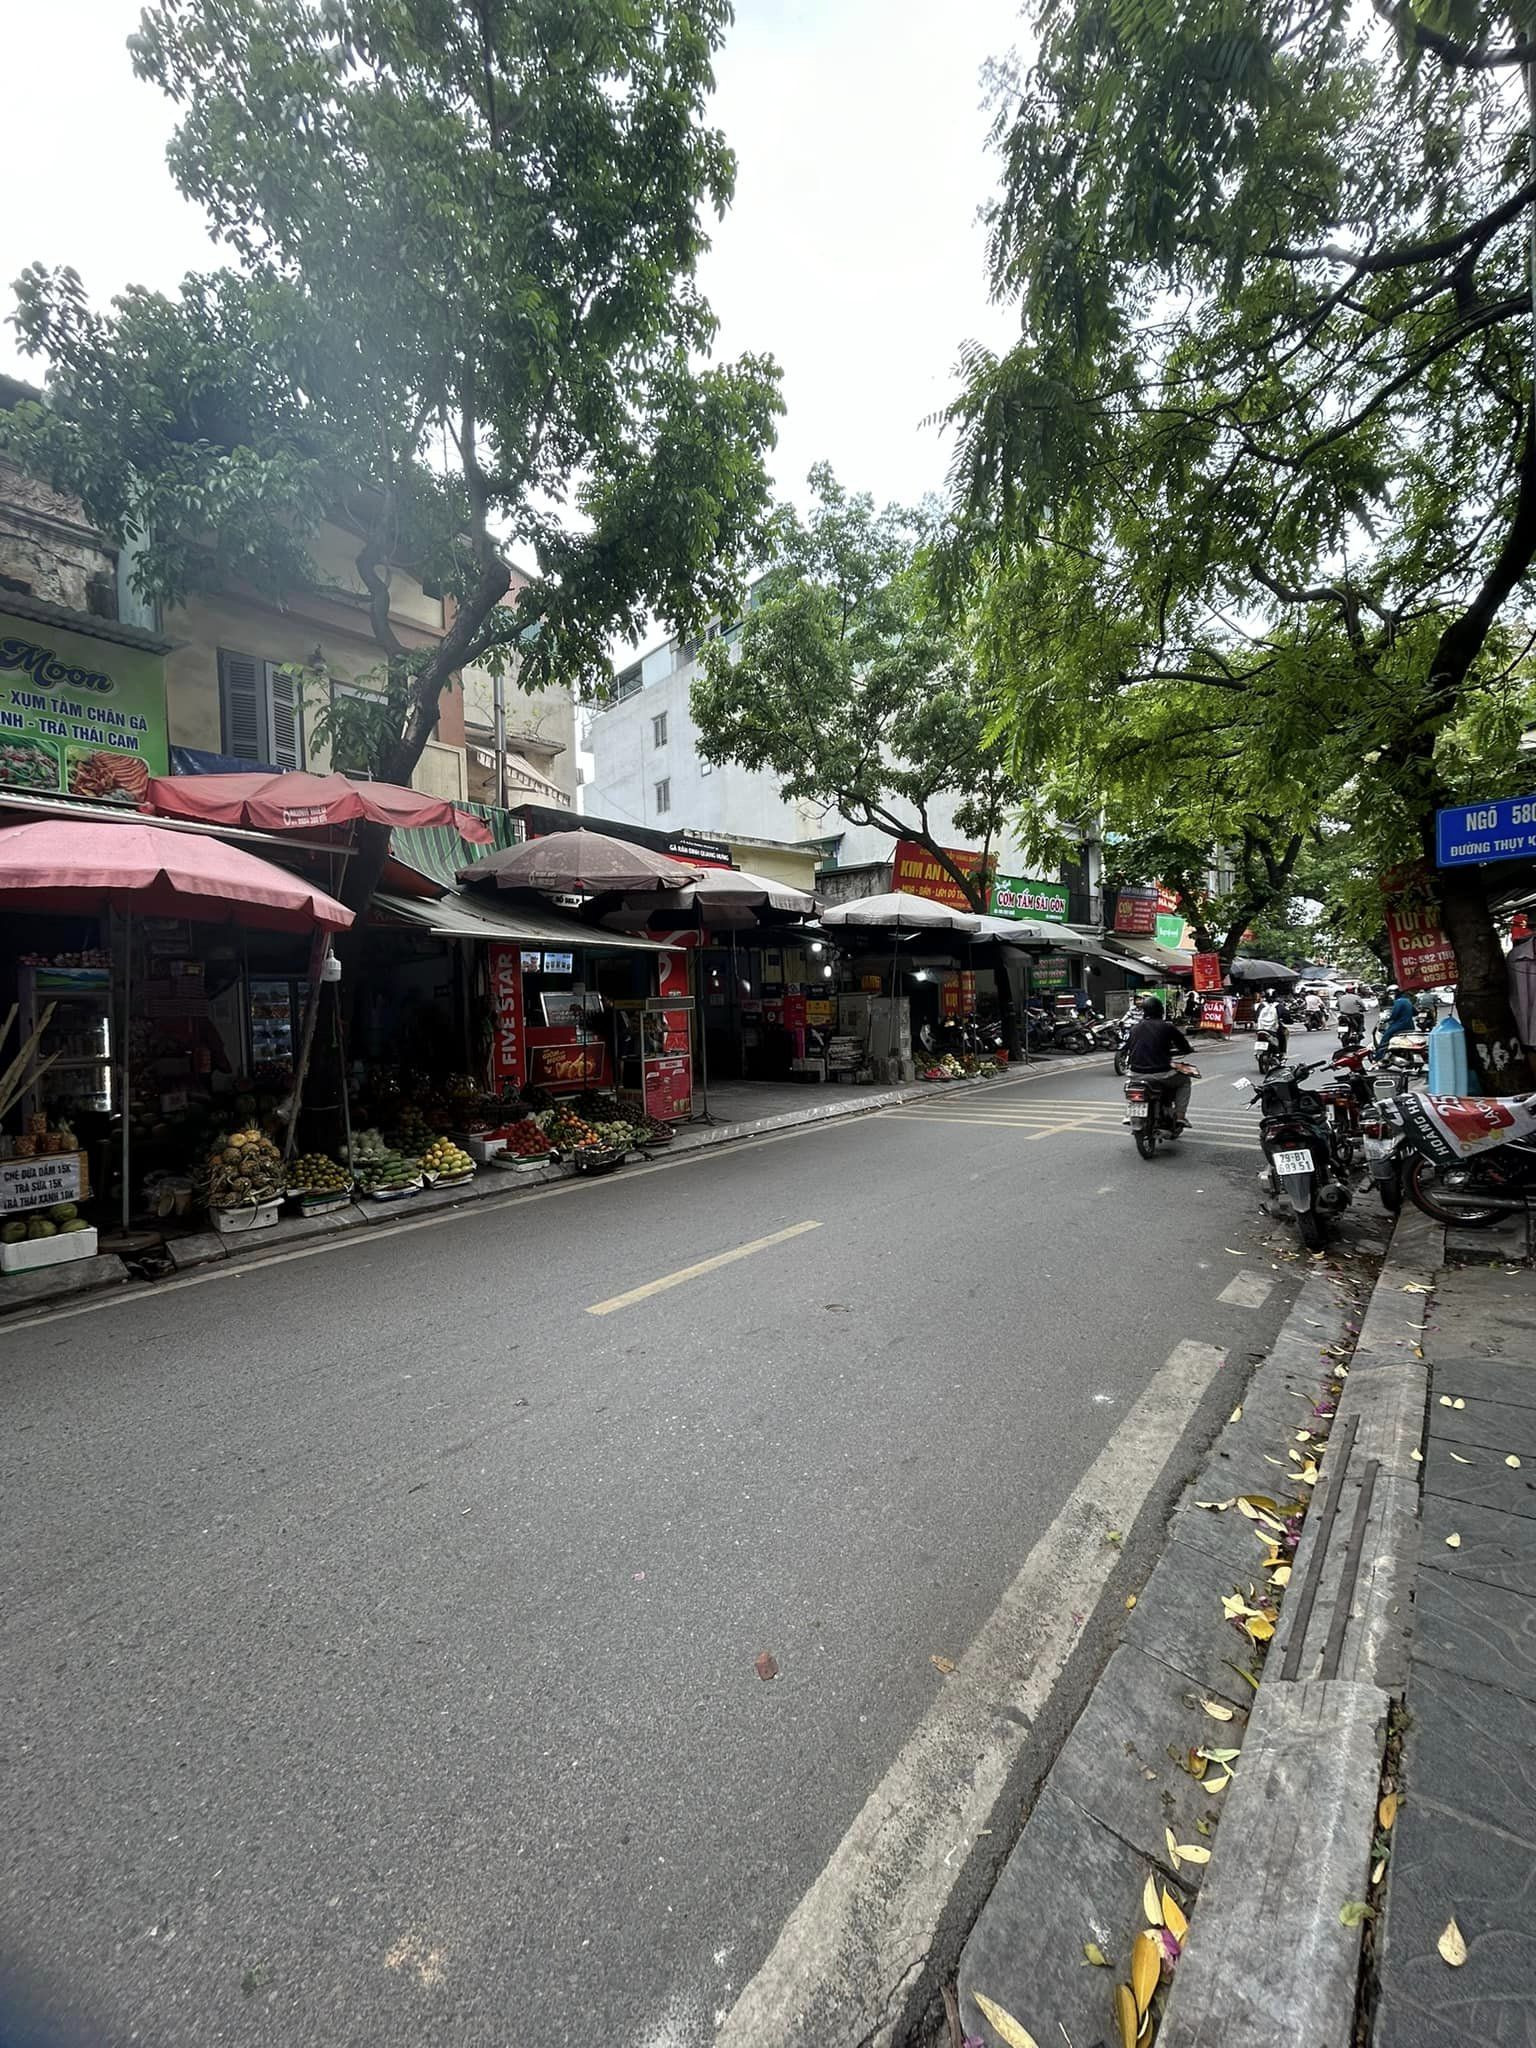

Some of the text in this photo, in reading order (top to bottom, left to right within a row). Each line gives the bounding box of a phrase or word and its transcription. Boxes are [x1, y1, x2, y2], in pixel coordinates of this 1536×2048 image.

[0, 638, 113, 692] Moon
[72, 726, 103, 743] THÁI
[108, 733, 139, 749] CAM
[1466, 806, 1498, 832] NGÕ
[1450, 841, 1491, 857] ĐƯỜNG
[1494, 837, 1524, 852] THỤY
[900, 860, 923, 879] KIM
[925, 863, 940, 881] AN
[1017, 887, 1034, 910] TẤM
[1035, 892, 1049, 911] SÀI
[1050, 894, 1066, 912] GÒN
[498, 952, 517, 1066] FIVE STAR
[1414, 1116, 1450, 1156] HOÀNG
